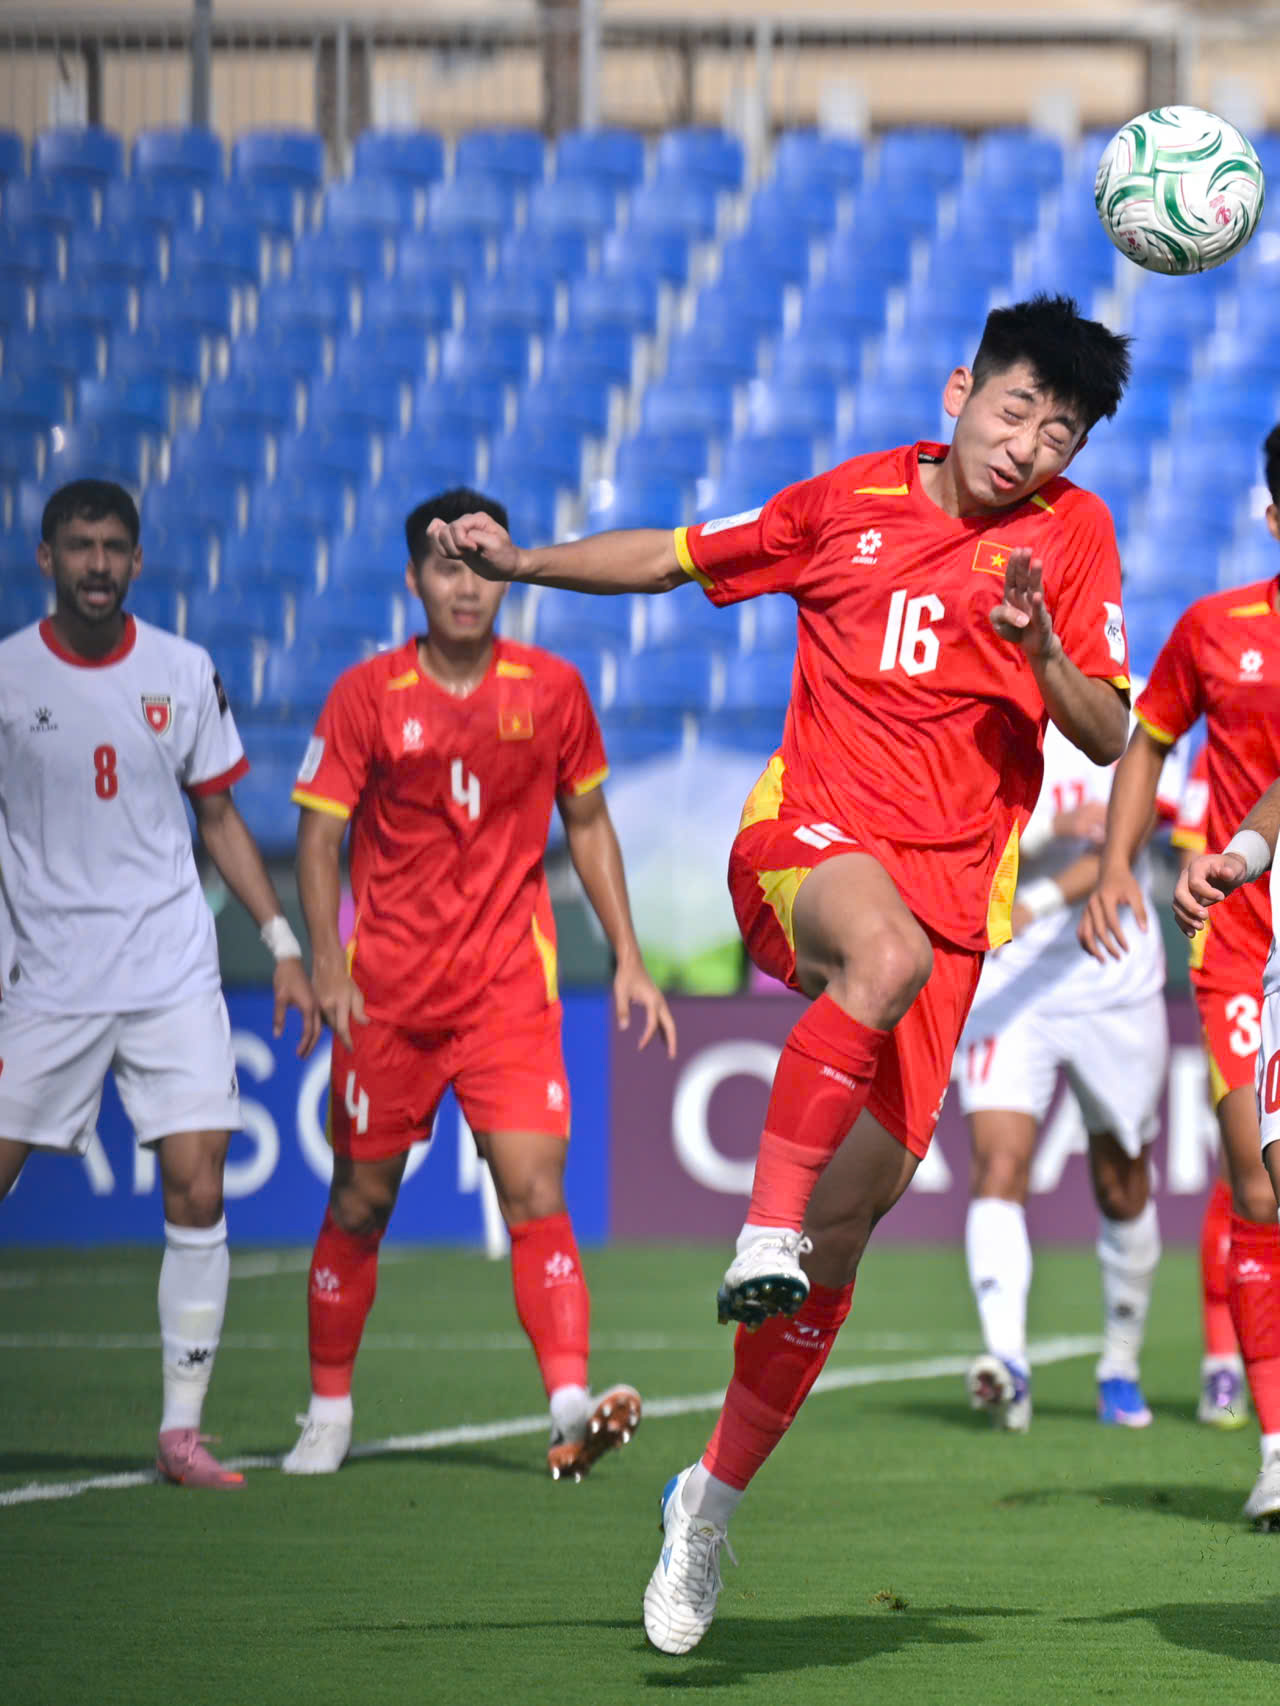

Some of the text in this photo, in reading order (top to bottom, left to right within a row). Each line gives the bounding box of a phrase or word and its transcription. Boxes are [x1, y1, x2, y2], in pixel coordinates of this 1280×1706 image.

[880, 589, 945, 677] 16
[94, 744, 118, 800] 8
[451, 758, 480, 821] 4
[1226, 994, 1262, 1057] 3
[968, 1036, 996, 1085] 17
[345, 1071, 369, 1135] 4
